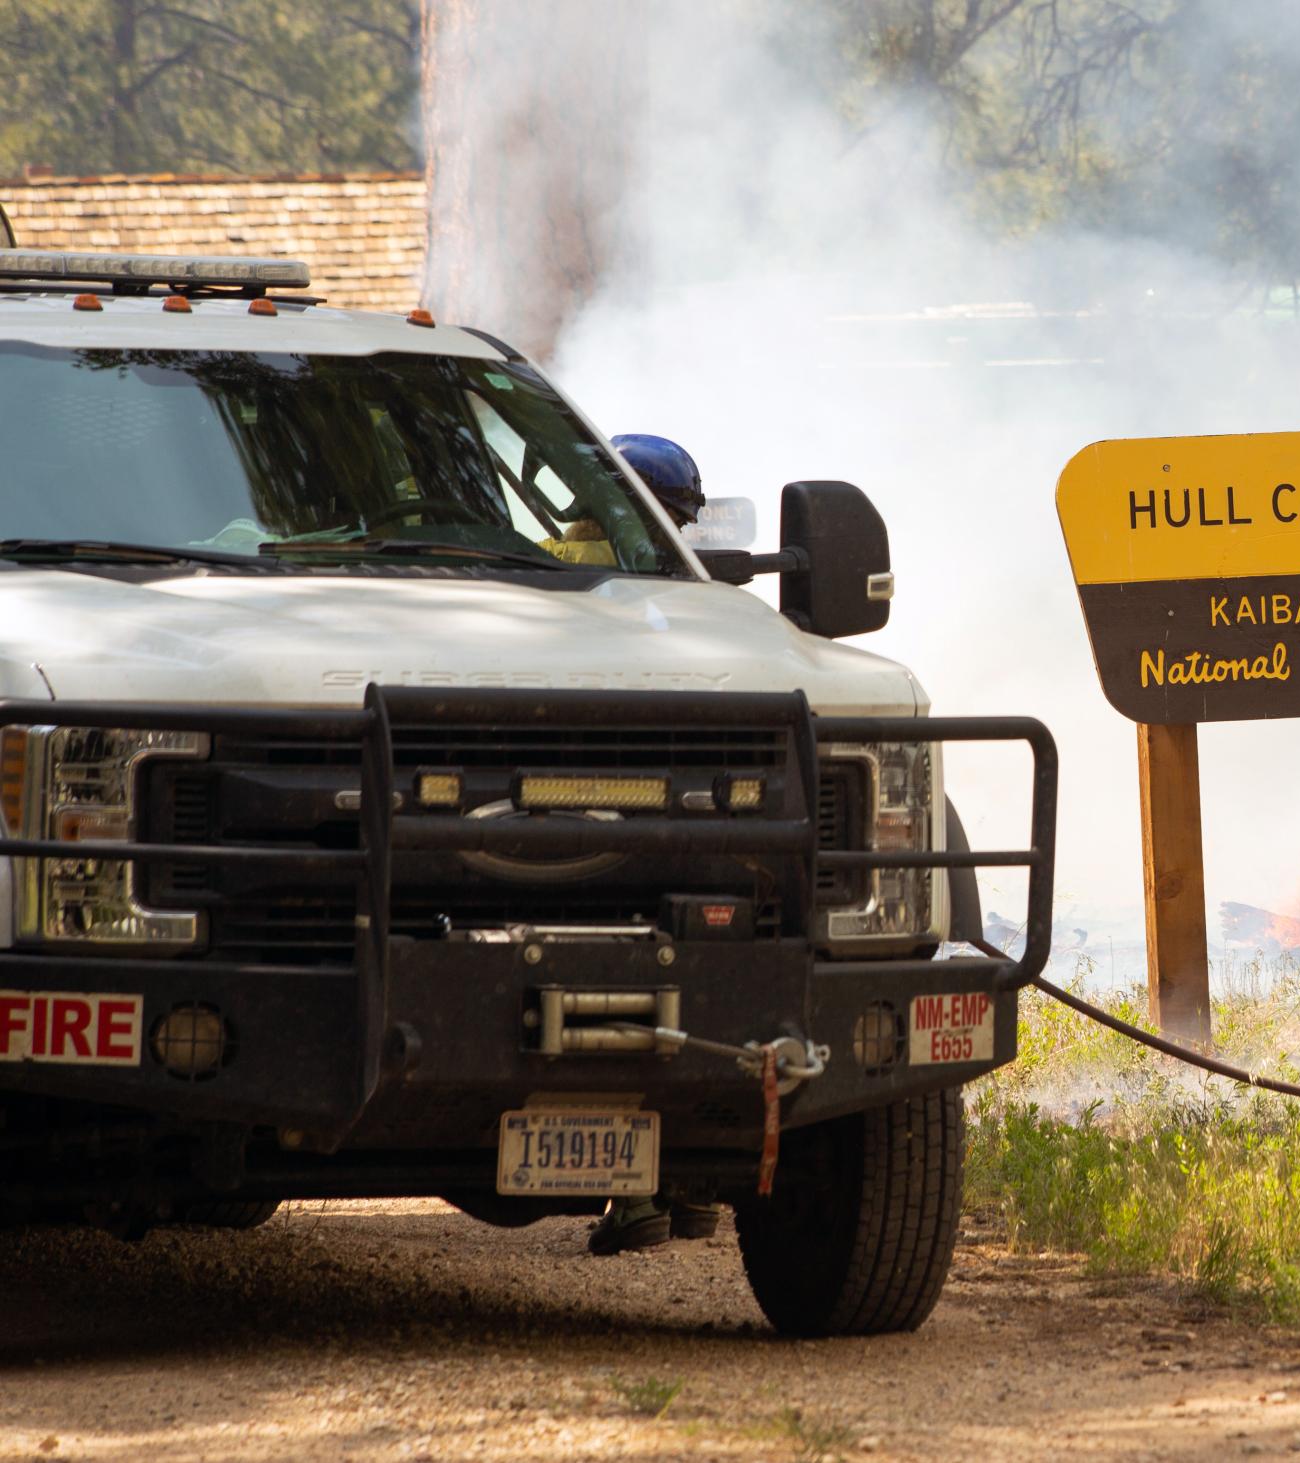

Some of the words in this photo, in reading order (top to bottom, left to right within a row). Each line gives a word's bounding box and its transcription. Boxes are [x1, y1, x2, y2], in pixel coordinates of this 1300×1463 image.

[702, 504, 743, 521] ONLY
[1128, 486, 1252, 530] HULL
[1140, 643, 1290, 688] National
[0, 997, 137, 1058] FIRE
[915, 993, 989, 1030] NM-EMP
[930, 1030, 973, 1061] E655
